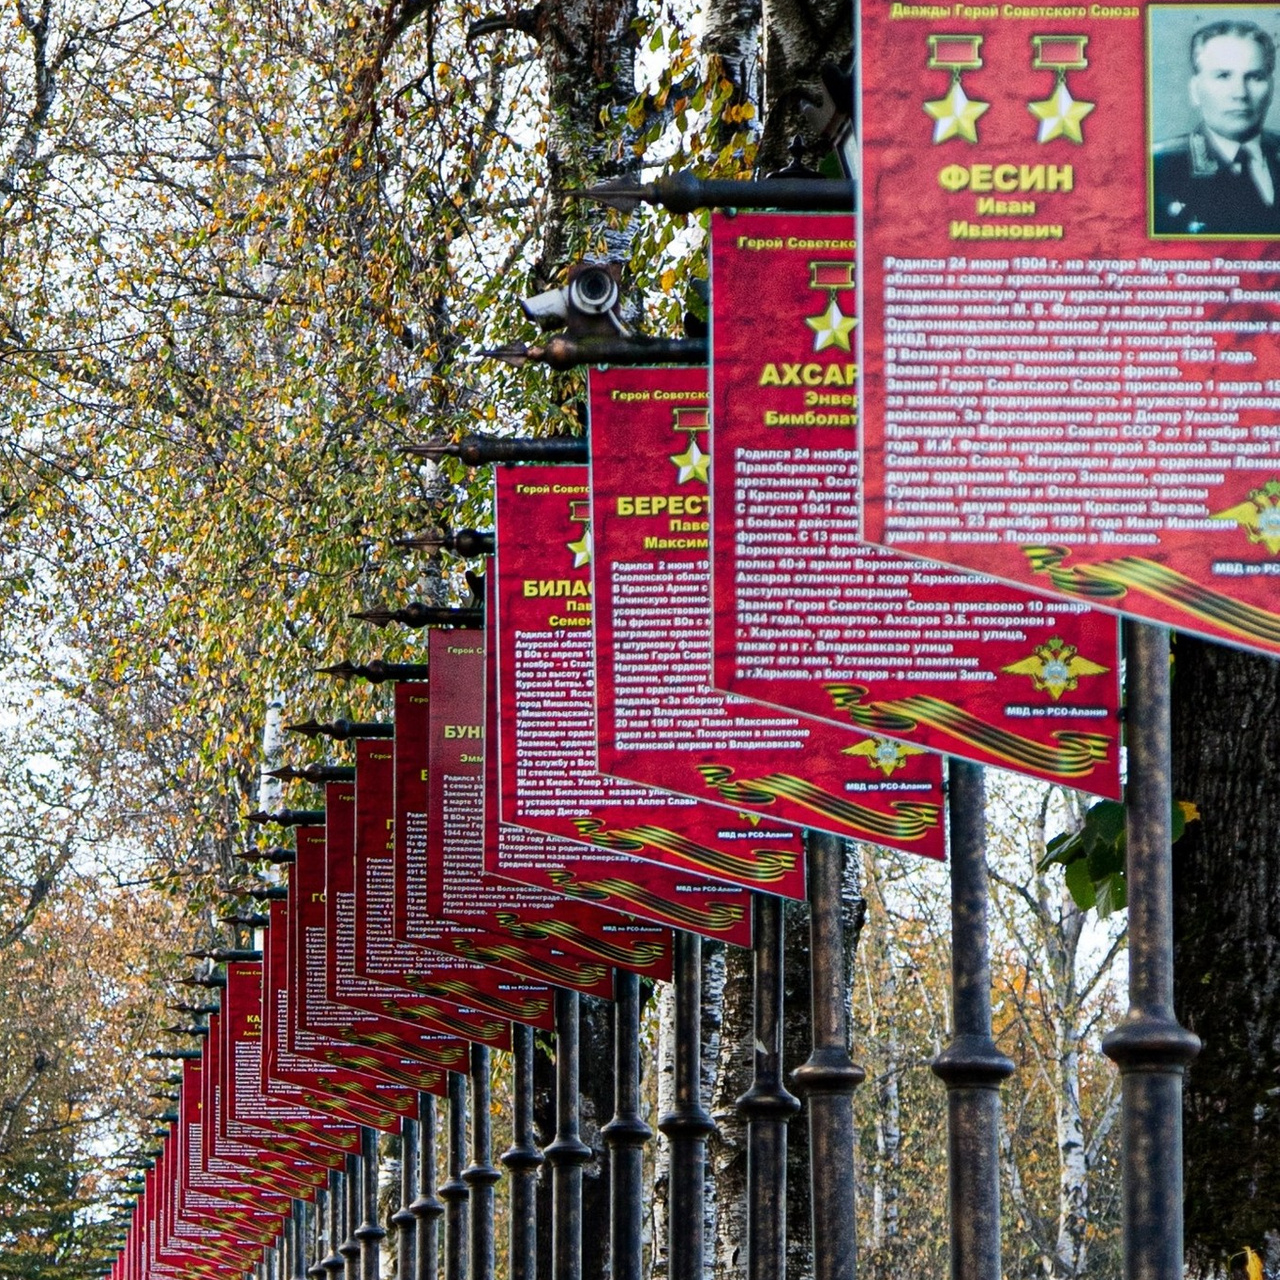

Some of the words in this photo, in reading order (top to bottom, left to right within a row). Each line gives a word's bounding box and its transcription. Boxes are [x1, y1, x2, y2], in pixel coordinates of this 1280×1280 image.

[890, 3, 950, 18] Дважды
[953, 4, 998, 19] Герой
[1002, 4, 1086, 17] Советского
[1090, 4, 1139, 17] Союза
[938, 164, 1072, 190] ФЕСИН
[977, 197, 1035, 213] Иван
[950, 221, 1062, 237] Иванович
[738, 236, 782, 249] Герой
[884, 256, 945, 270] Родился
[949, 257, 966, 270] 24
[968, 259, 1008, 270] июня
[1013, 257, 1047, 269] 1904
[1049, 260, 1061, 269] г.
[1064, 259, 1083, 270] на
[1086, 260, 1136, 272] хуторе
[1138, 258, 1210, 272] Муравлев
[885, 272, 943, 284] области
[946, 275, 955, 285] в
[958, 274, 1003, 285] семье
[1006, 274, 1103, 286] крестьянина.
[1105, 273, 1172, 287] Русский.
[1175, 273, 1239, 285] Окончил
[736, 448, 790, 459] Родился
[794, 448, 809, 459] 24
[813, 448, 859, 460] ноября
[886, 531, 924, 543] ушел
[926, 531, 946, 541] из
[948, 531, 1001, 542] жизни.
[1004, 530, 1086, 544] Похоронен
[1087, 533, 1098, 543] в
[1099, 531, 1160, 543] Москве.
[1214, 563, 1243, 574] МВД
[1245, 565, 1261, 573] по
[737, 599, 783, 610] Звание
[786, 599, 825, 612] Героя
[828, 600, 902, 611] Советского
[905, 600, 950, 611] Союза
[953, 602, 1024, 612] присвоено
[1027, 600, 1043, 611] 10
[1045, 600, 1092, 613] января
[737, 612, 767, 623] 1944
[770, 615, 803, 625] года,
[806, 615, 881, 624] посмертно.
[884, 614, 940, 625] Ахсаров
[944, 613, 969, 625] Э.Б.
[973, 616, 1044, 625] похоронен
[1046, 617, 1055, 625] в
[736, 628, 747, 636] г.
[750, 627, 815, 639] Харькове,
[816, 629, 840, 639] где
[843, 629, 865, 638] его
[868, 629, 920, 638] именем
[923, 630, 979, 639] названа
[982, 630, 1026, 641] улица,
